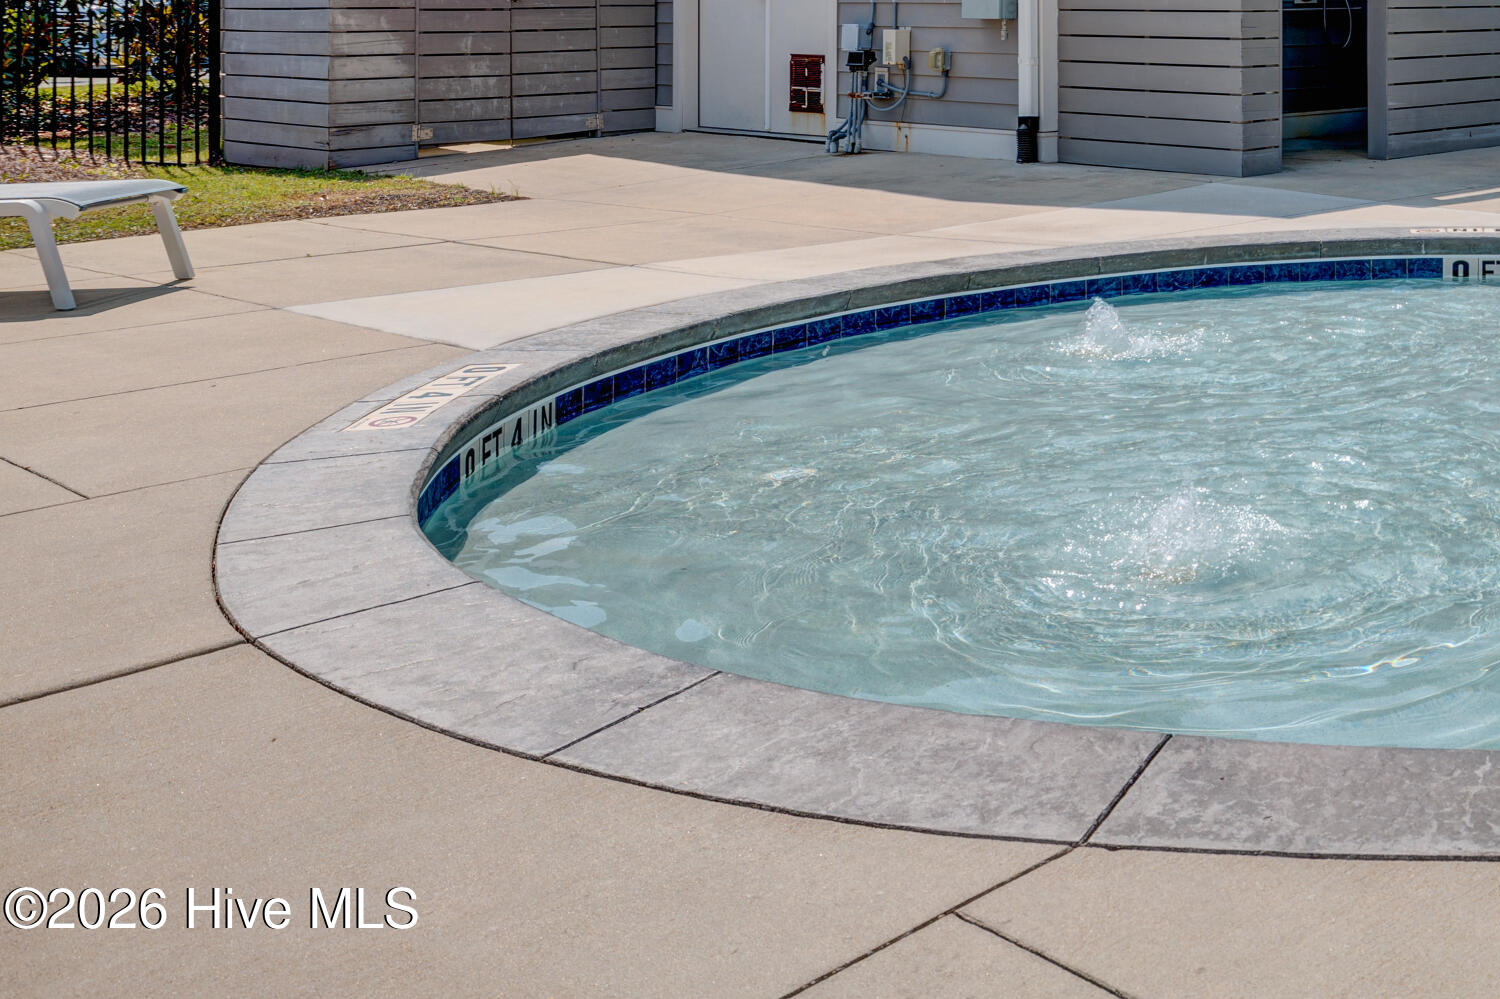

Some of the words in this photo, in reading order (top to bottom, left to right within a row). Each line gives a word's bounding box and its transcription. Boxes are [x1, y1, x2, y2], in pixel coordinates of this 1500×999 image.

[408, 391, 454, 399] 4
[482, 427, 503, 466] FT
[511, 417, 523, 447] 4
[533, 402, 552, 438] IN
